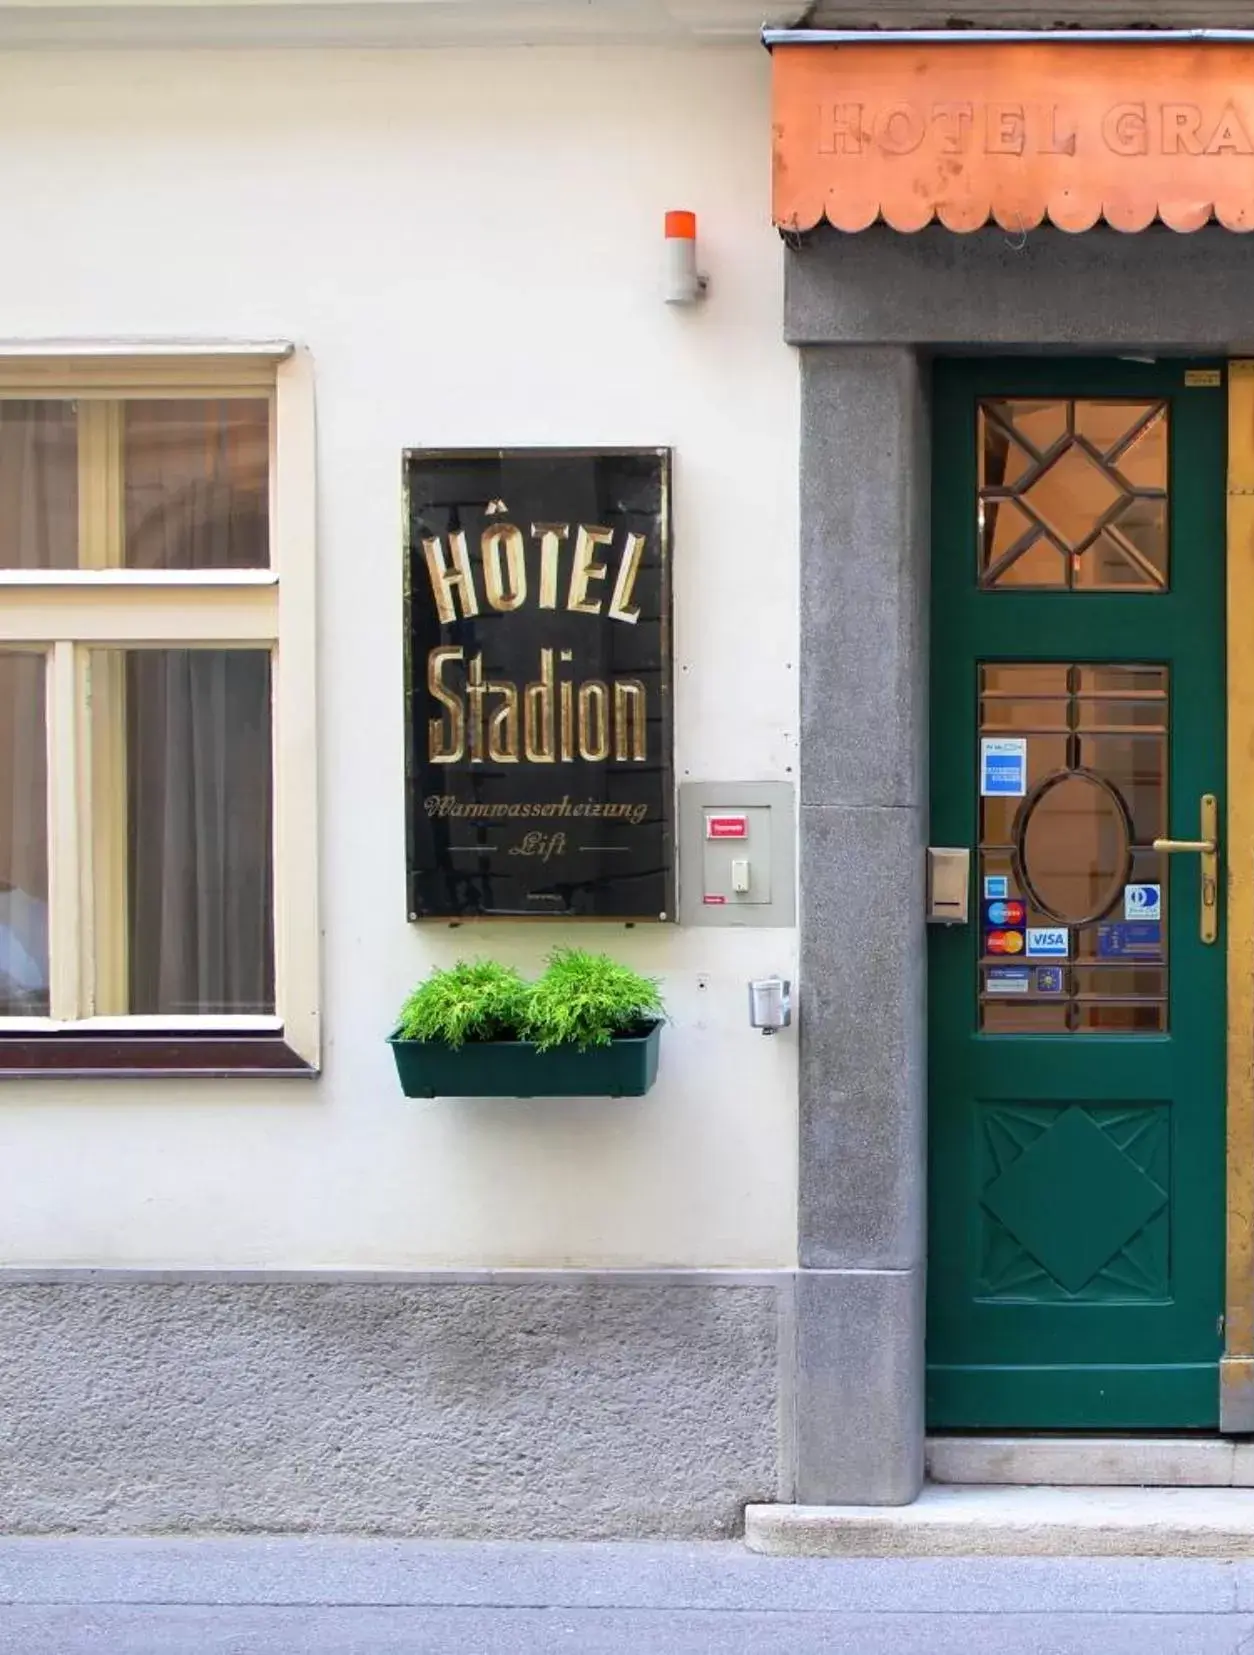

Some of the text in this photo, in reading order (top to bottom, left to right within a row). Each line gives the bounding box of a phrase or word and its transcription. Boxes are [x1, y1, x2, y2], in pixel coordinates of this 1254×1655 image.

[816, 101, 1077, 157] HOTEL
[422, 500, 646, 624] HÔTEL
[427, 645, 647, 764] Stadion
[423, 794, 649, 825] Warmwasserheizung
[509, 830, 567, 864] Lift
[1034, 932, 1064, 945] VISA
